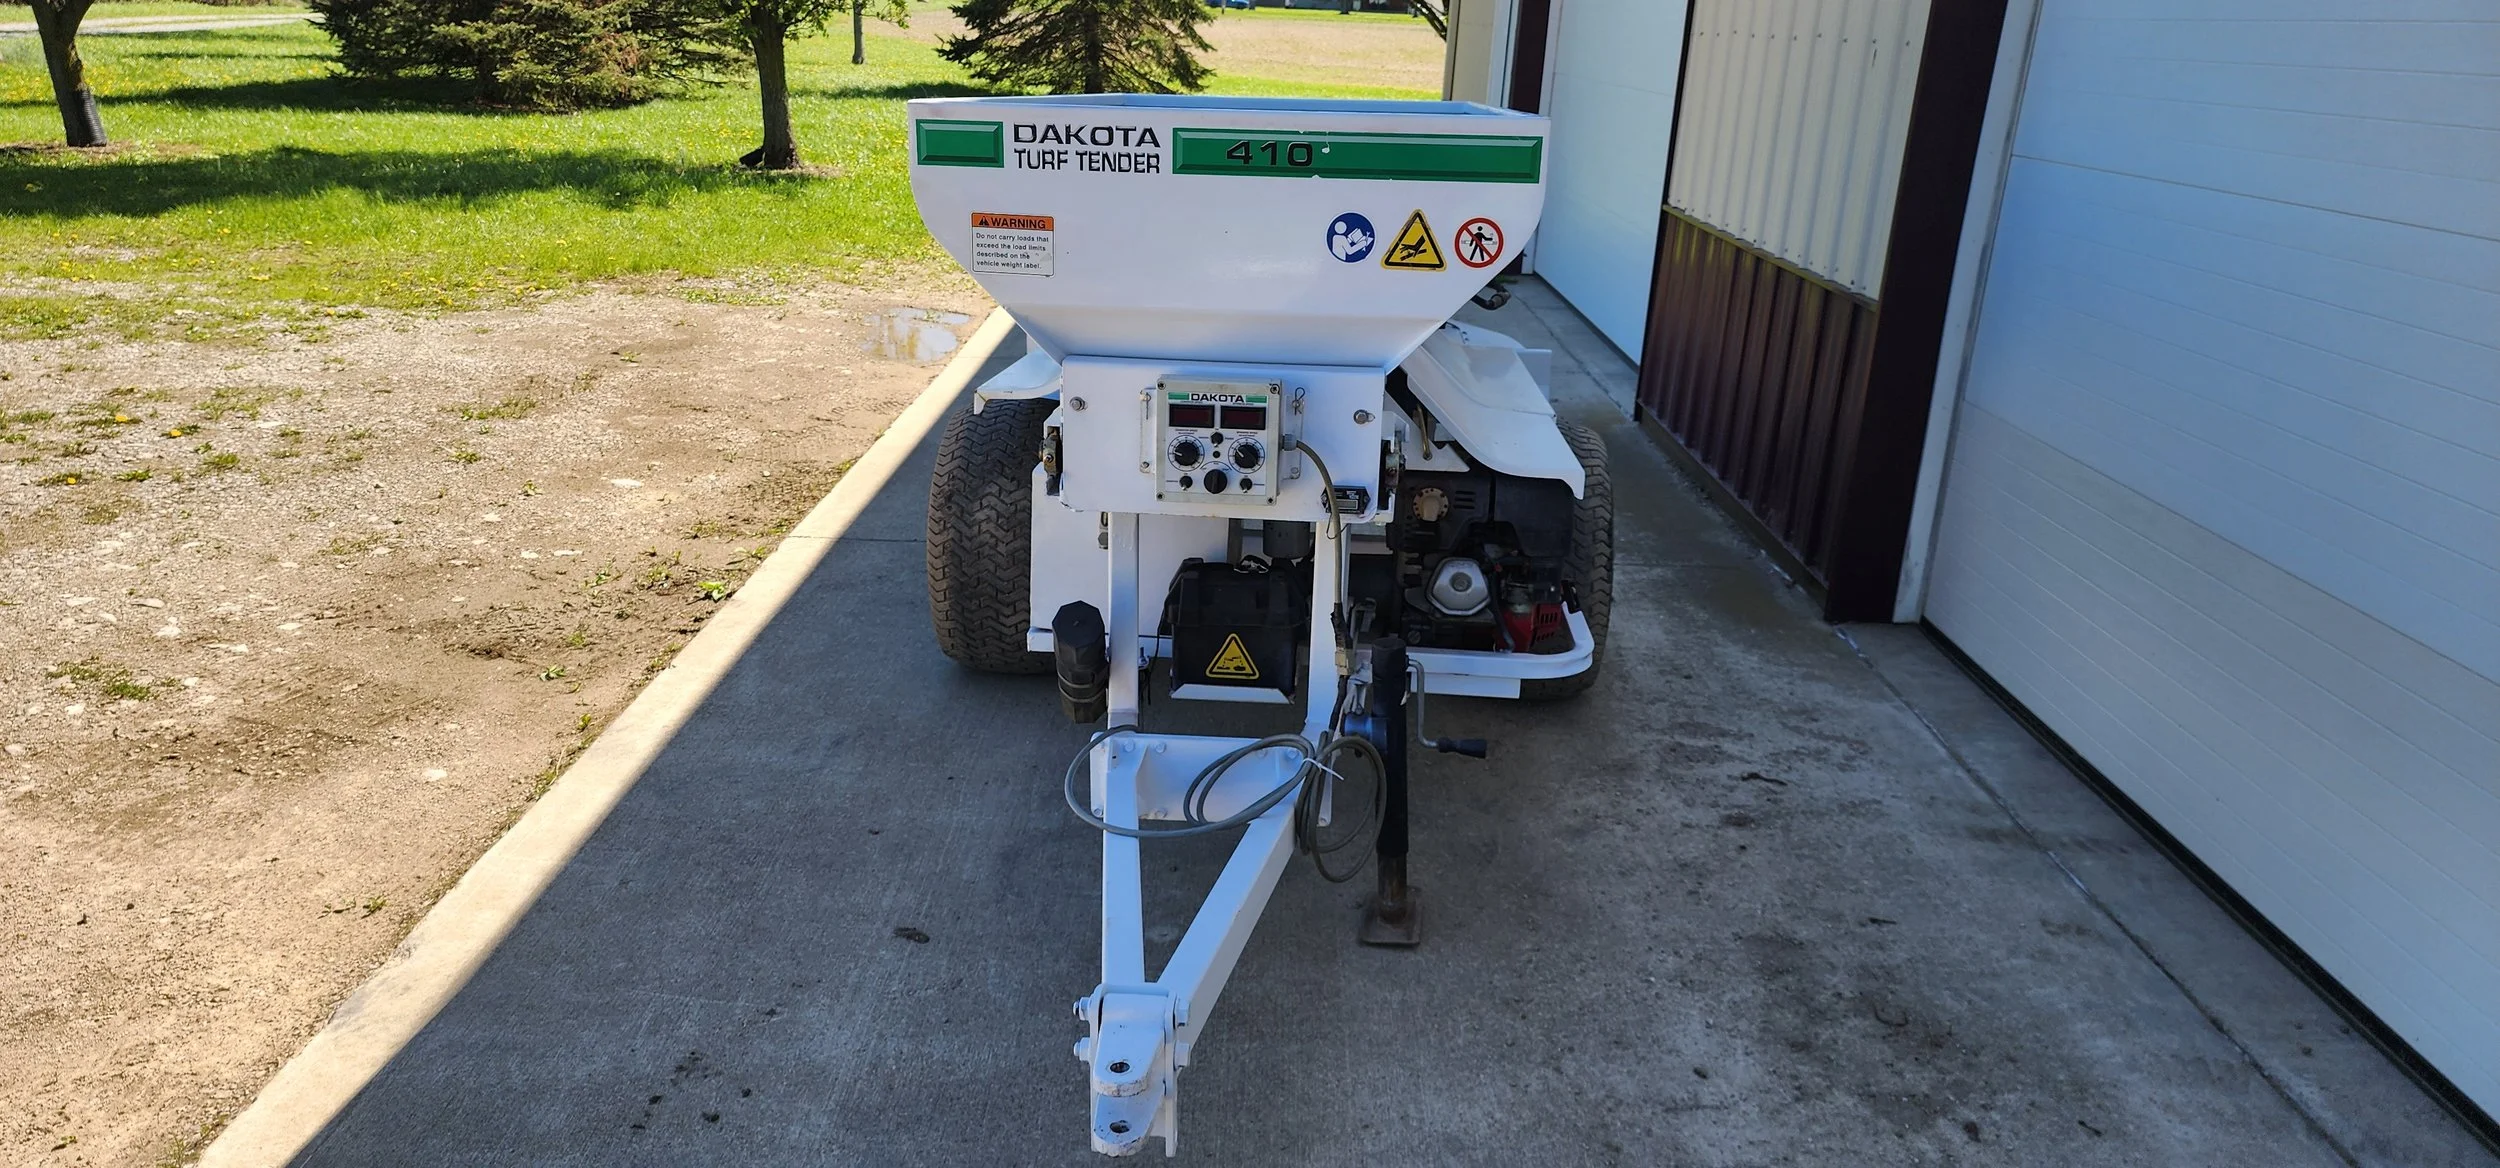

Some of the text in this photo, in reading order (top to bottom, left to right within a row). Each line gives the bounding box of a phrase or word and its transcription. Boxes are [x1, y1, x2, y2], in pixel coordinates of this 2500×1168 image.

[1013, 122, 1161, 148] DAKOTA
[1226, 140, 1313, 167] 410
[1014, 148, 1160, 174] TURF TENDER
[990, 217, 1046, 229] WARNING
[1019, 252, 1030, 260] the
[1001, 261, 1023, 269] weight
[1190, 393, 1245, 403] DAKOTA
